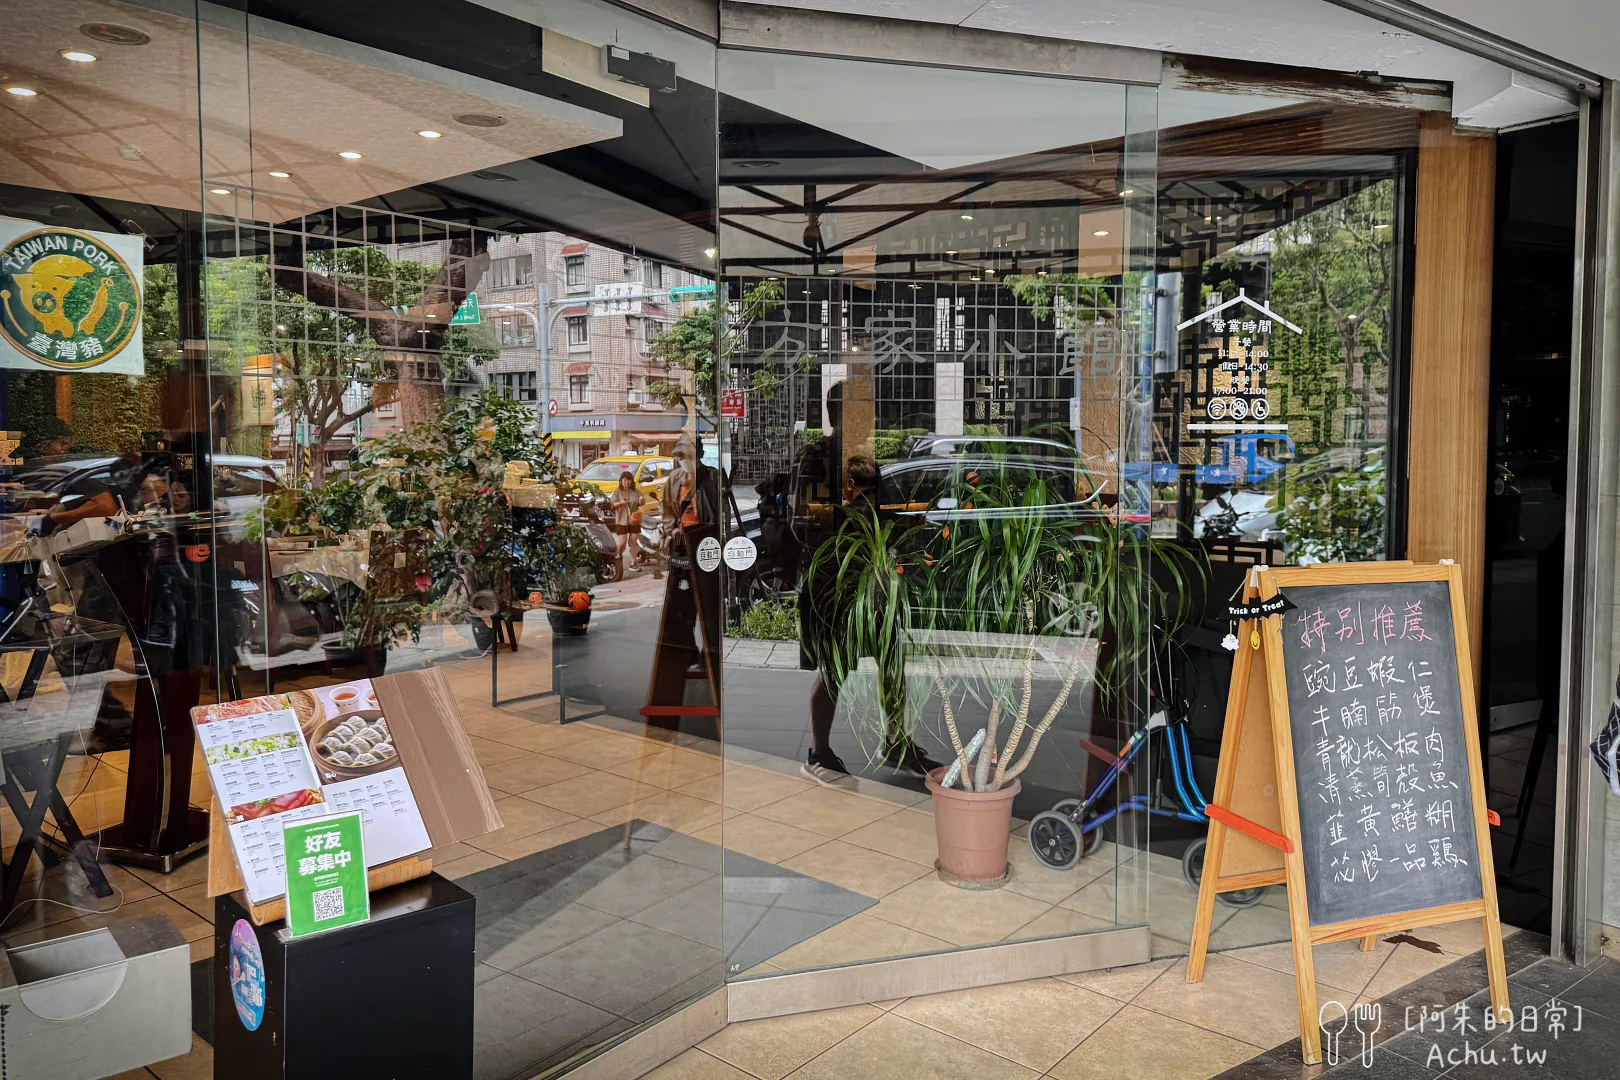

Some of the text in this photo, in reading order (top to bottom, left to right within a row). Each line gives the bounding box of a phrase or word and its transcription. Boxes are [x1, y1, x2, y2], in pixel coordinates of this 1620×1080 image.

[4, 235, 118, 275] TAIWAN PORK
[755, 308, 1121, 378] 方家小館
[1211, 319, 1272, 334] 營業時間
[27, 331, 104, 359] 臺灣豬
[1228, 607, 1248, 615] Trick
[1262, 599, 1285, 612] Treat
[1297, 600, 1432, 653] 特別推薦
[1302, 655, 1433, 698] 豌豆蝦仁
[1311, 685, 1441, 736] 牛腩筋煲
[304, 831, 342, 854] 好友
[298, 849, 352, 877] 募集中
